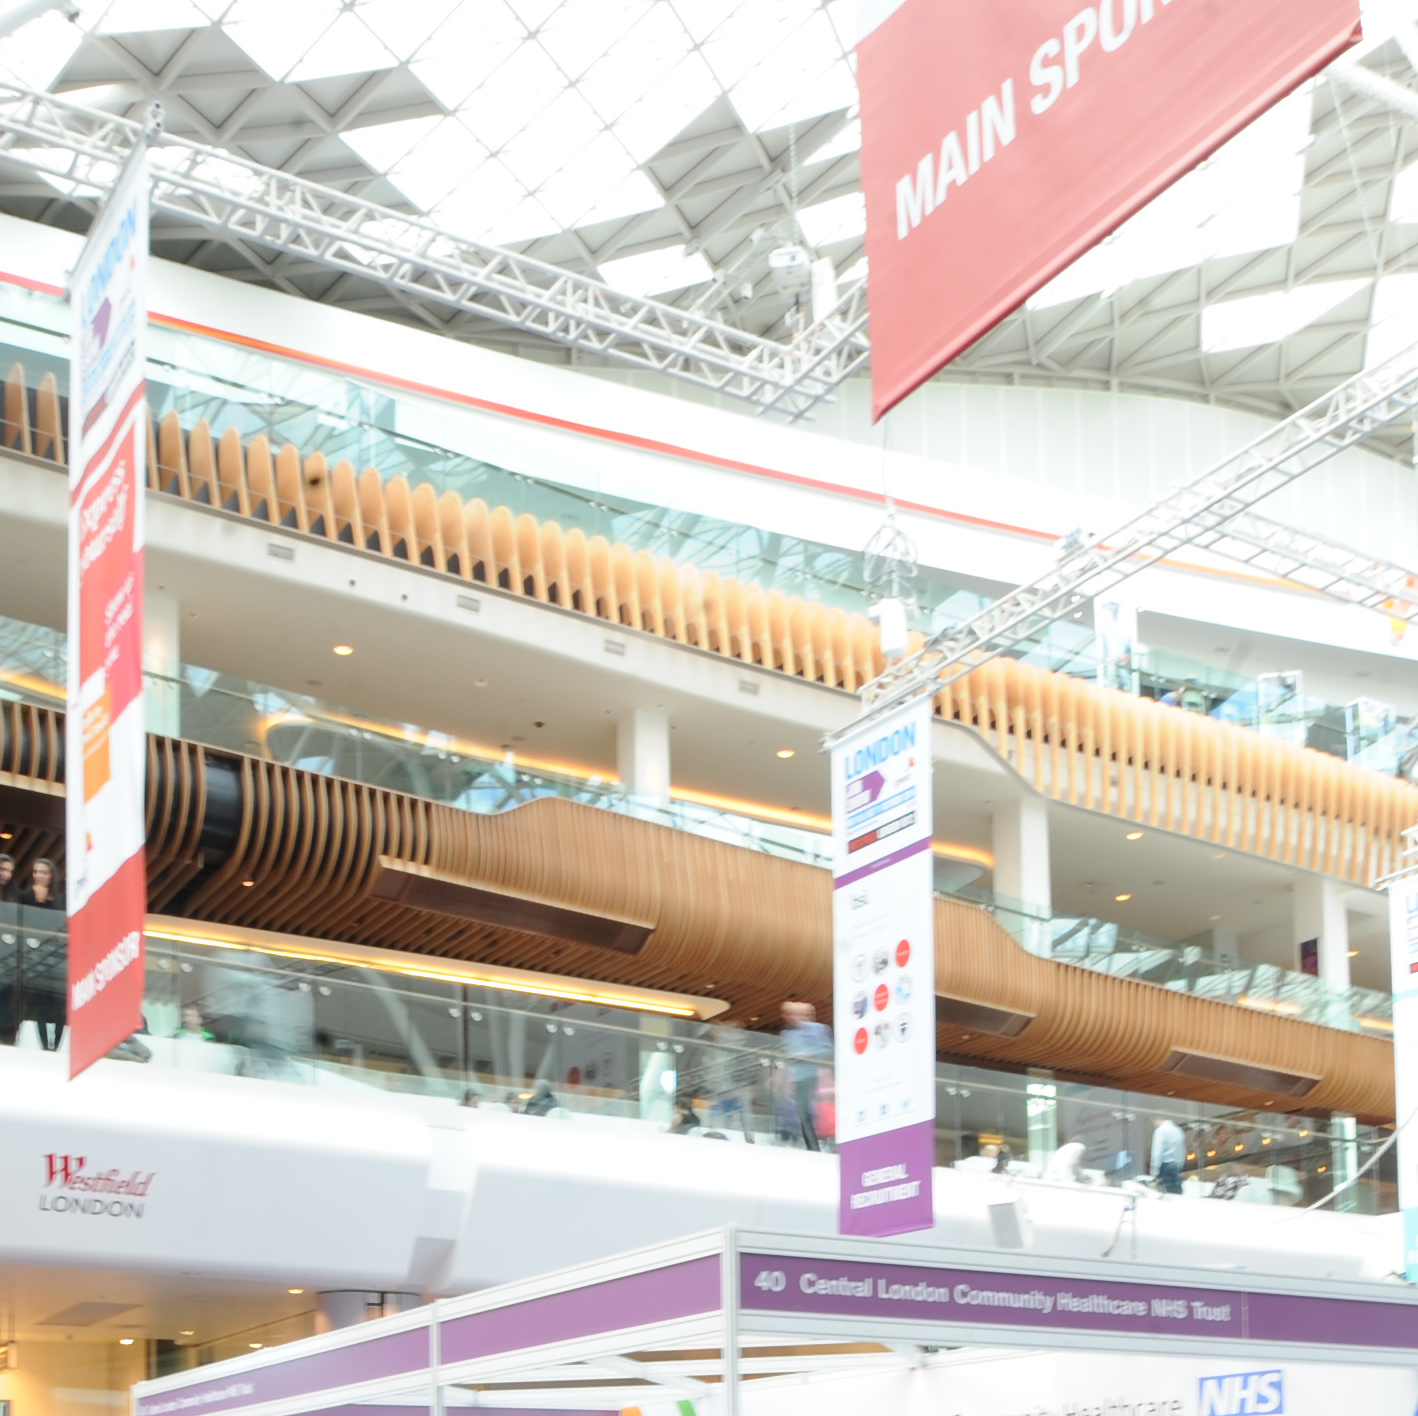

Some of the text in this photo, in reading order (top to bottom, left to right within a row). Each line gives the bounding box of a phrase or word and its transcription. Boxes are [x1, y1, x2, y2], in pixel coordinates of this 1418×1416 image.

[895, 77, 1017, 241] MAIN
[845, 721, 916, 780] LONDON
[42, 1152, 157, 1197] Westfield
[38, 1195, 145, 1218] LONDON
[754, 1270, 1232, 1322] 40 Central London Community Healthcare NHS Trust
